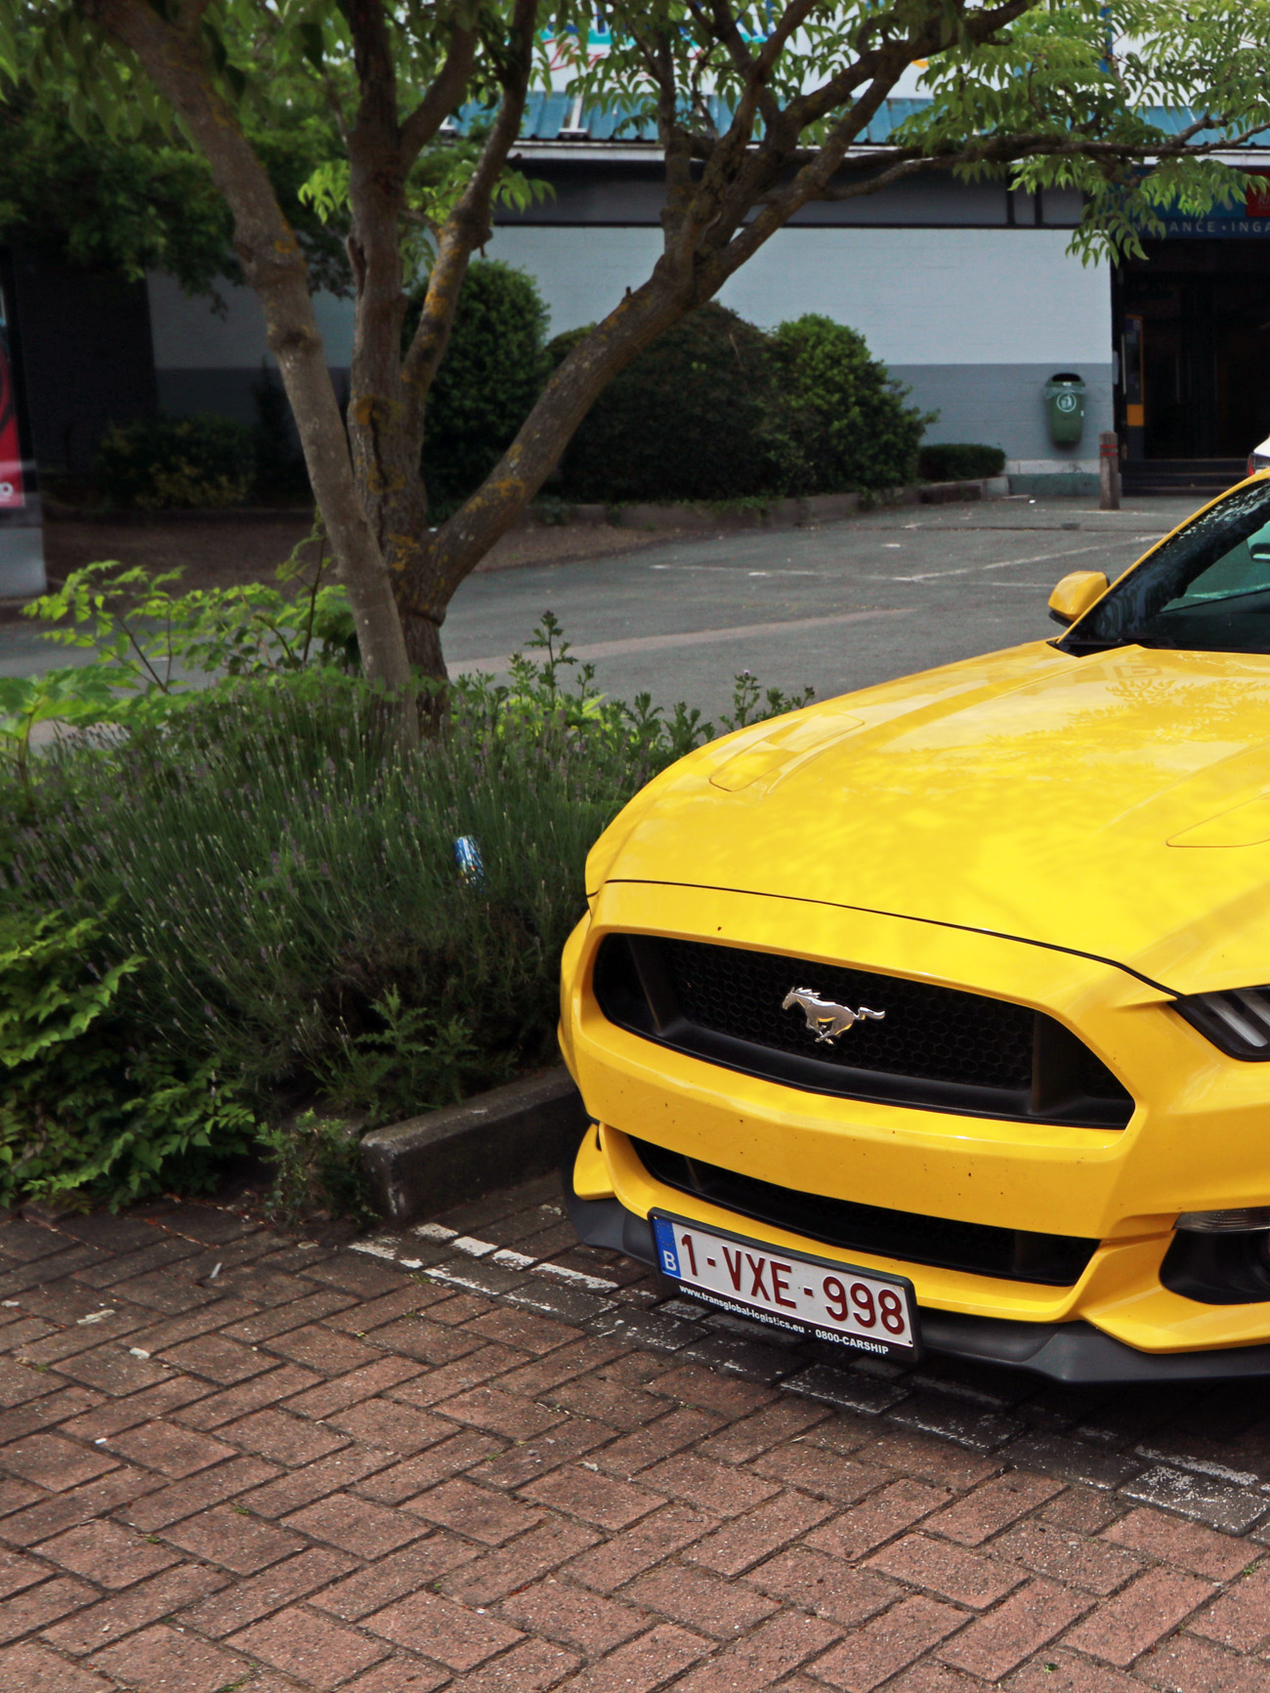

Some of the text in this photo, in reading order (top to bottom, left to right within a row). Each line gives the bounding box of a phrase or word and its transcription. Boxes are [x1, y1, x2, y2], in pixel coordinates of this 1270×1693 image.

[663, 1233, 905, 1336] B 1-VXE-998
[679, 1284, 889, 1355] www.transglobal-logistics.eu 0800-CARSHIP
